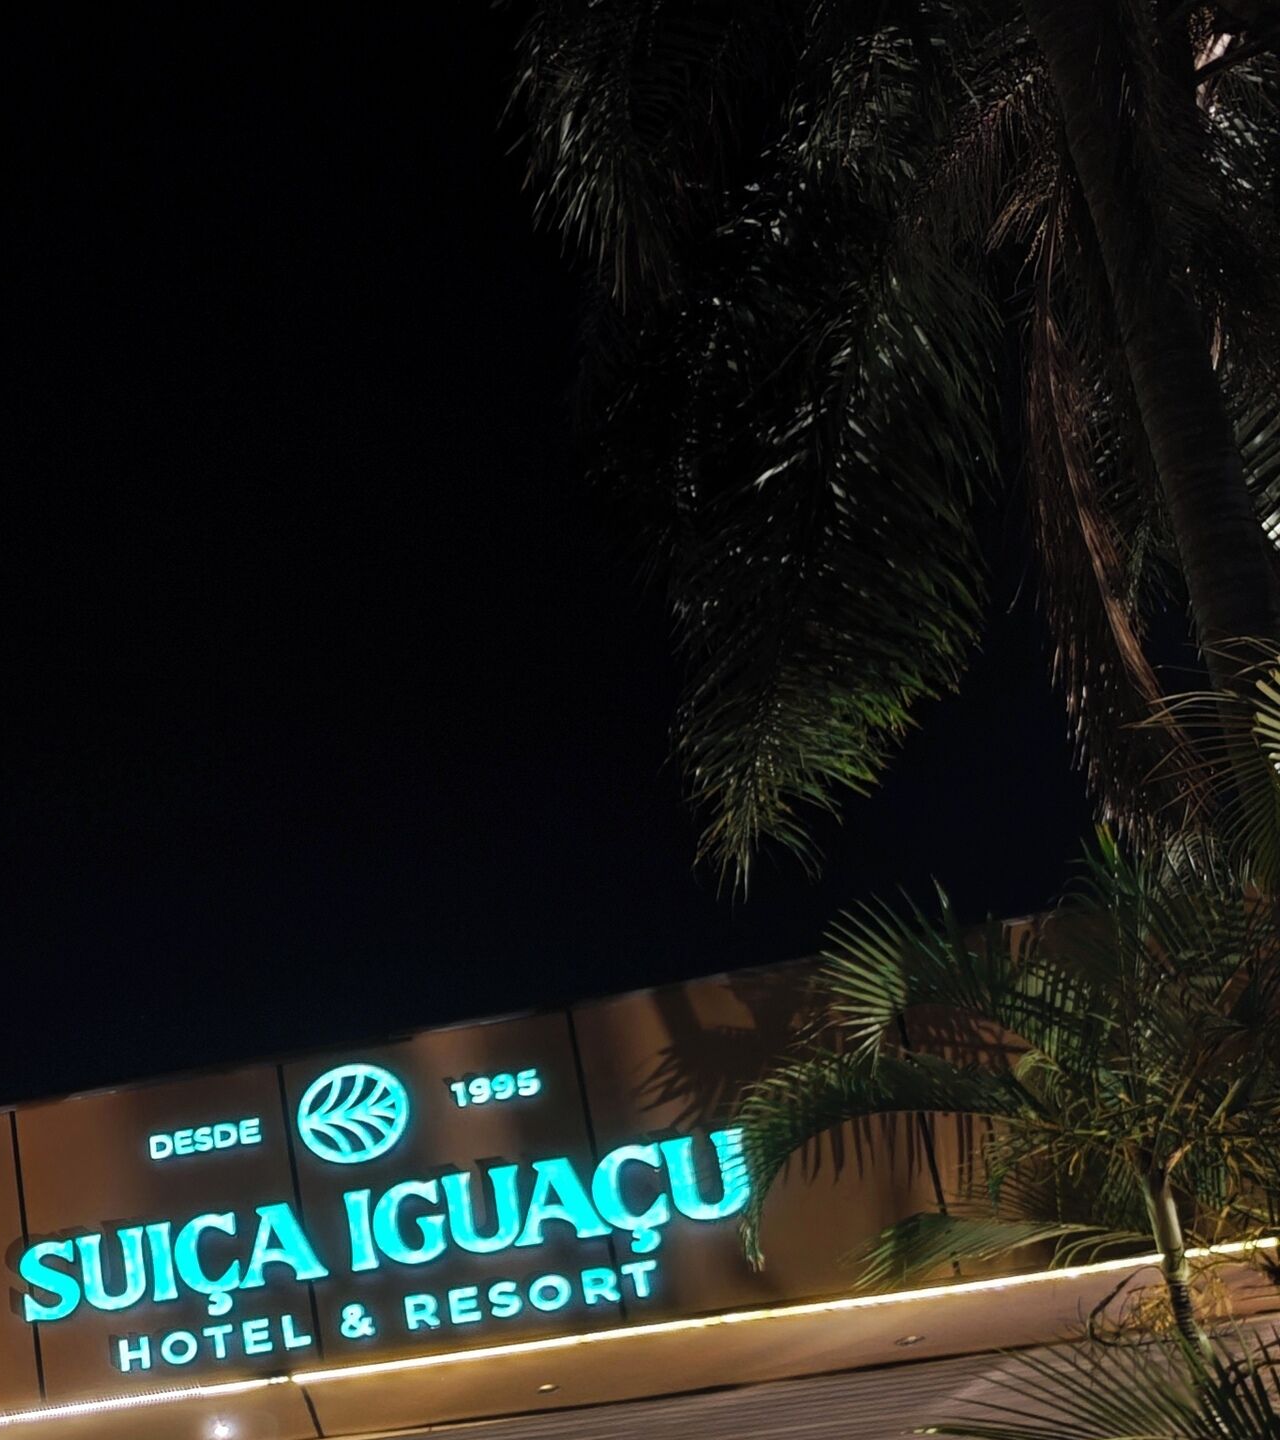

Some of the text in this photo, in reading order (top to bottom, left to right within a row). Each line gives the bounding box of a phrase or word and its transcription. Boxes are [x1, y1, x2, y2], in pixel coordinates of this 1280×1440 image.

[149, 1068, 542, 1160] DESDE 1995
[18, 1127, 752, 1323] SUIÇA IGUAÇU
[117, 1258, 658, 1373] HOTEL & RESORT
